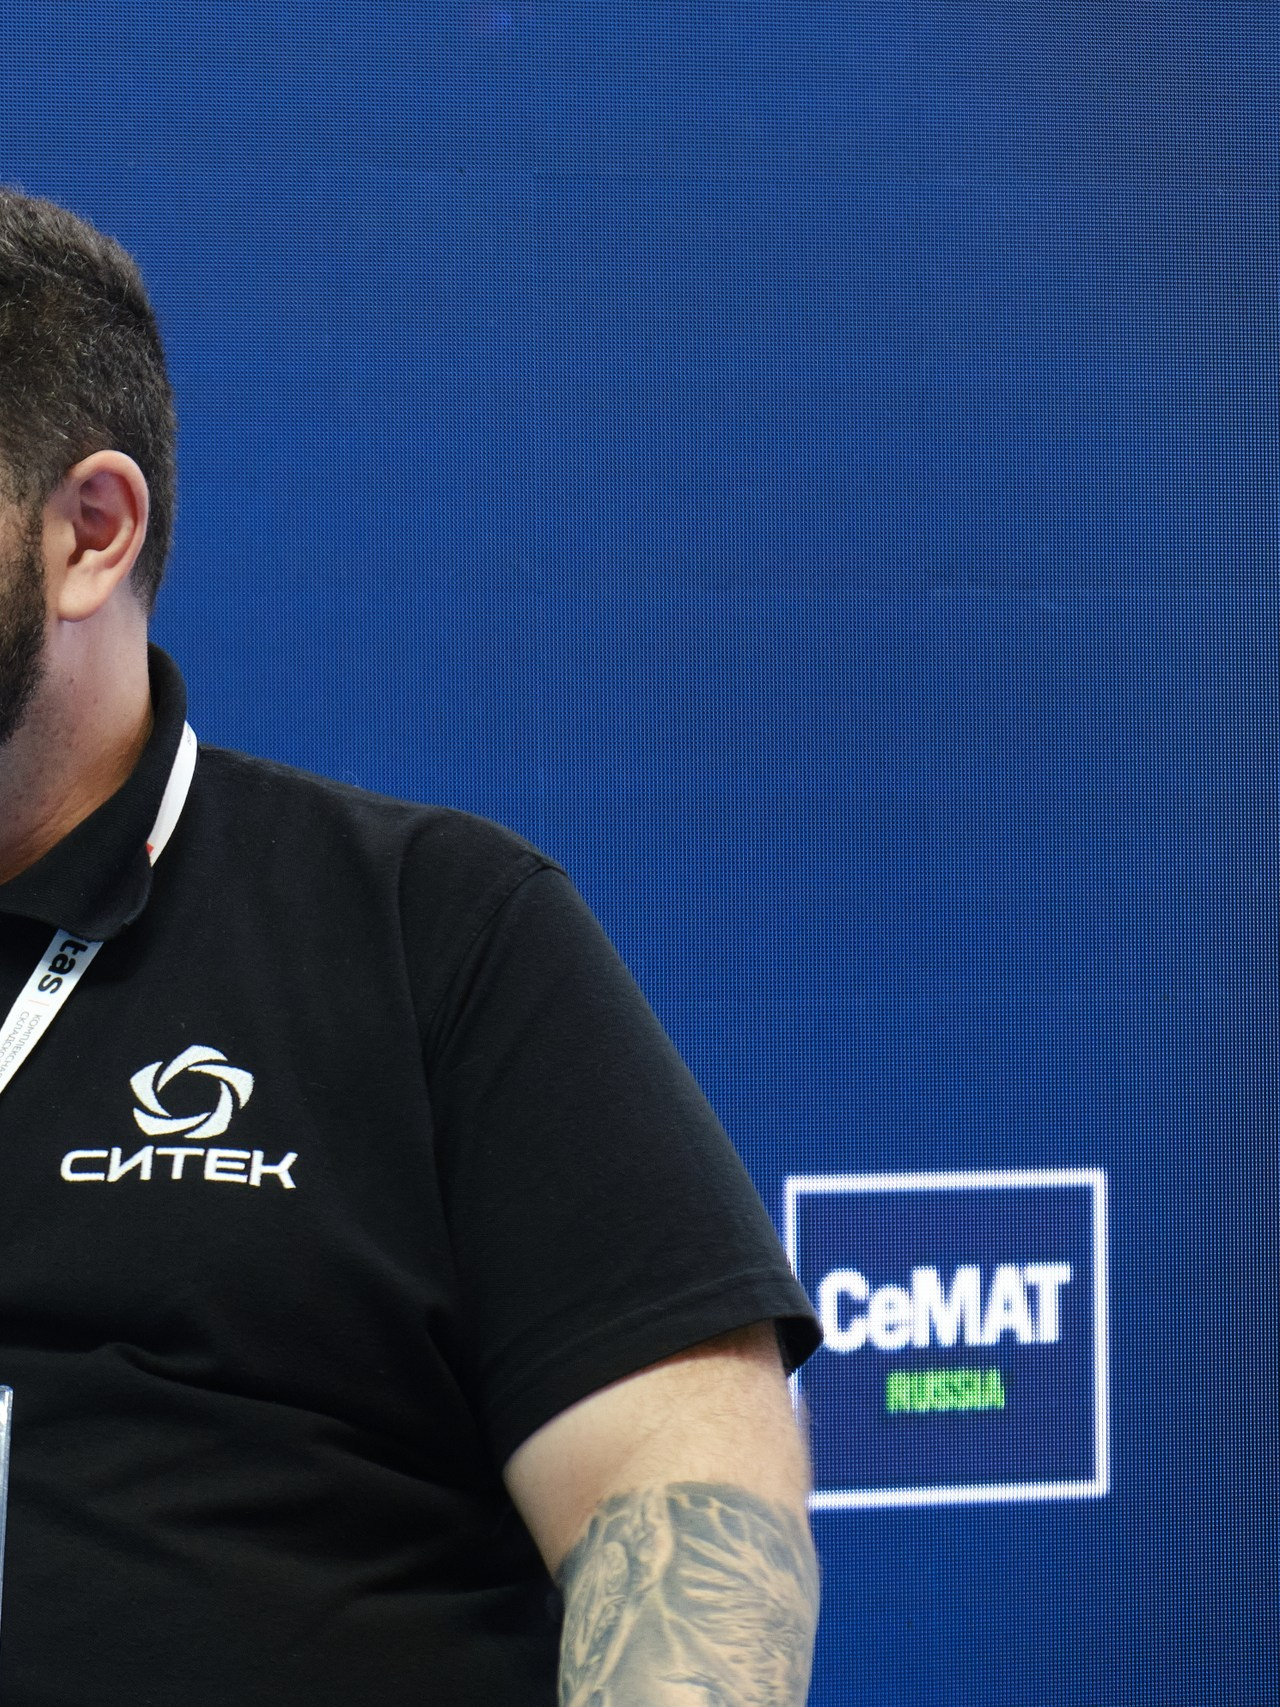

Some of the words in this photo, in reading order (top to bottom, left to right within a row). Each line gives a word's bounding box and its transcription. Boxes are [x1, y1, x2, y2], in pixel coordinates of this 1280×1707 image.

[60, 1145, 298, 1189] СИТЕК
[817, 1261, 1072, 1353] CeMAT
[886, 1367, 1006, 1413] RUSSIA
